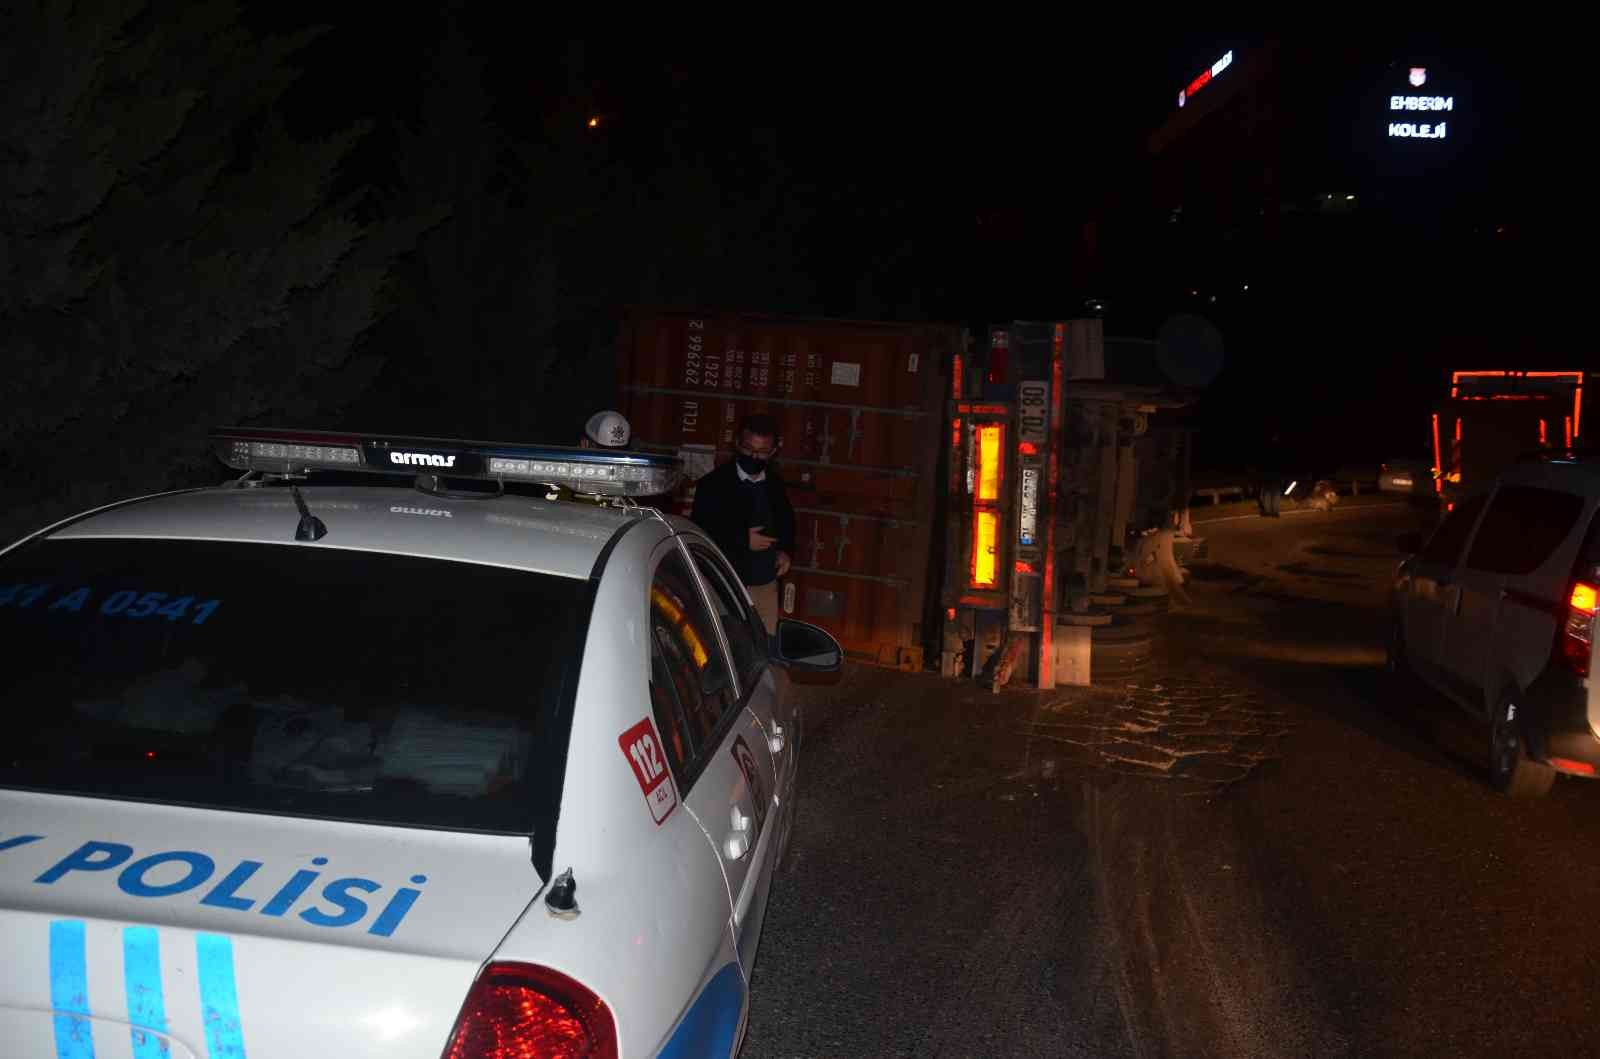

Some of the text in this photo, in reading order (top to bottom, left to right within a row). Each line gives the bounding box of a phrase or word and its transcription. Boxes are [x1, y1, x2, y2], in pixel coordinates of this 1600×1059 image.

[682, 319, 704, 432] TCLU 292966 2
[703, 354, 720, 387] 22G1
[390, 451, 456, 467] armas
[50, 587, 92, 613] A
[98, 590, 224, 625] 0541
[629, 733, 664, 785] 112
[33, 840, 428, 938] POLİSİ
